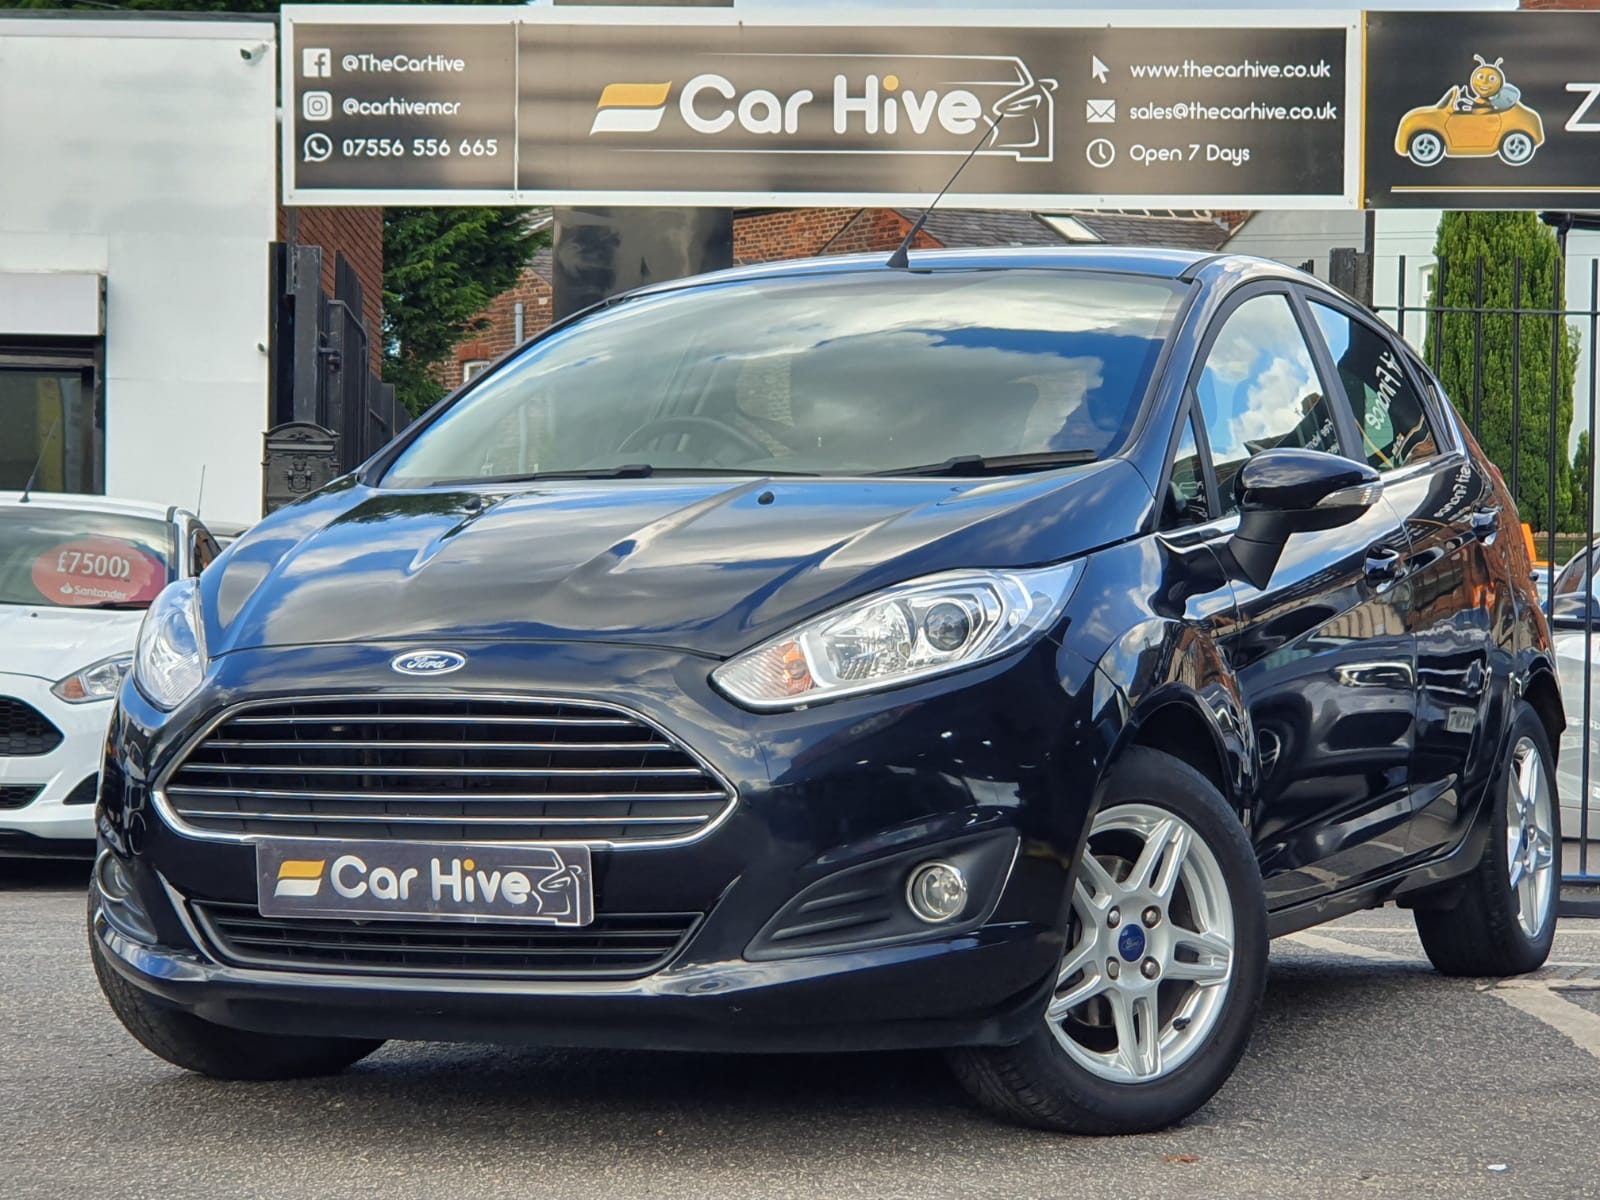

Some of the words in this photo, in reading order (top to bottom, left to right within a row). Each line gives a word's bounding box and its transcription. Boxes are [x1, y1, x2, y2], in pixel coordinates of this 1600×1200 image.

[342, 53, 466, 72] @TheCarHive
[1129, 59, 1332, 79] www.thecarhive.co.uk
[342, 97, 462, 117] @carhivemcr
[679, 73, 814, 134] Car
[833, 74, 983, 135] Hive
[1129, 101, 1338, 121] sales@thecarhive.co.uk
[342, 139, 405, 157] 07556
[412, 139, 451, 157] 556
[459, 139, 498, 157] 665
[1129, 144, 1183, 167] Open
[1187, 144, 1201, 161] 7
[1206, 143, 1251, 168] Days
[74, 584, 128, 599] Santander
[406, 655, 449, 669] Ford
[330, 854, 418, 900] Car
[430, 858, 532, 905] Hive
